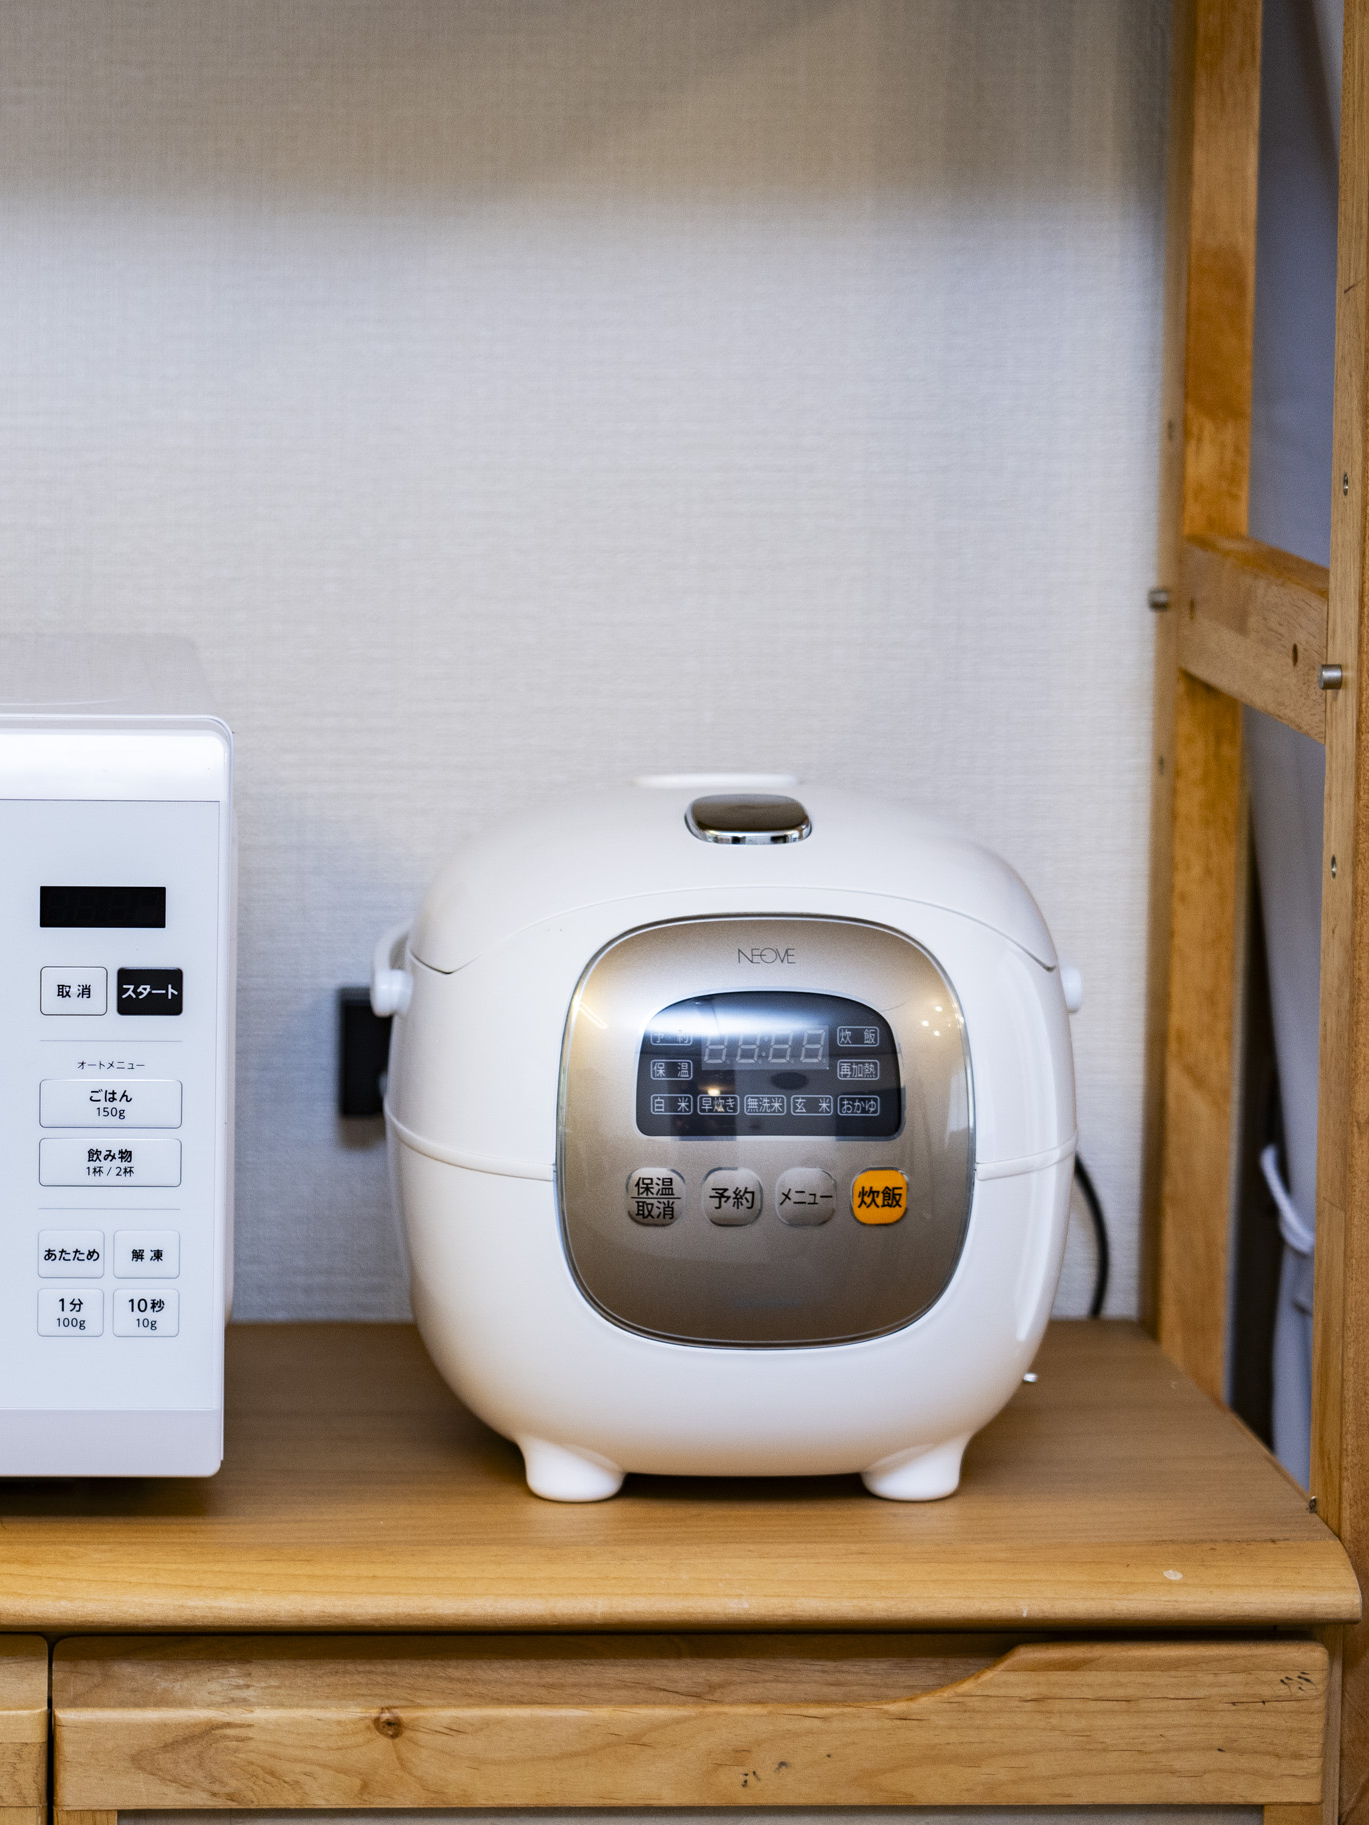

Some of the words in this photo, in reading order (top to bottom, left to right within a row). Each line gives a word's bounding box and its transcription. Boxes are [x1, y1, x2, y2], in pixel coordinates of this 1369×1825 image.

[737, 947, 796, 965] NEOVE
[56, 984, 92, 999] 取消
[121, 984, 179, 1000] スタート
[839, 1030, 876, 1045] 炊飯
[77, 1060, 146, 1070] オートメニュー
[653, 1062, 690, 1078] 保温
[839, 1063, 876, 1078] 再加熱
[89, 1088, 133, 1103] ごはん
[654, 1097, 690, 1112] 白米
[700, 1097, 737, 1113] 早炊き
[747, 1097, 783, 1113] 無洗米
[794, 1097, 831, 1113] 玄米
[841, 1098, 877, 1113] おかゆ
[95, 1106, 126, 1120] 150g
[87, 1148, 133, 1163] 飲み物
[634, 1176, 675, 1197] 保温
[709, 1187, 755, 1210] 予約
[779, 1189, 833, 1206] メニュー
[857, 1186, 903, 1209] 炊飯
[634, 1200, 675, 1220] 取消
[43, 1248, 100, 1262] あたため
[131, 1249, 164, 1262] 解凍
[58, 1298, 84, 1313] 1分
[128, 1298, 165, 1313] 10秒
[56, 1317, 86, 1331] 100g
[135, 1317, 158, 1331] 10g
